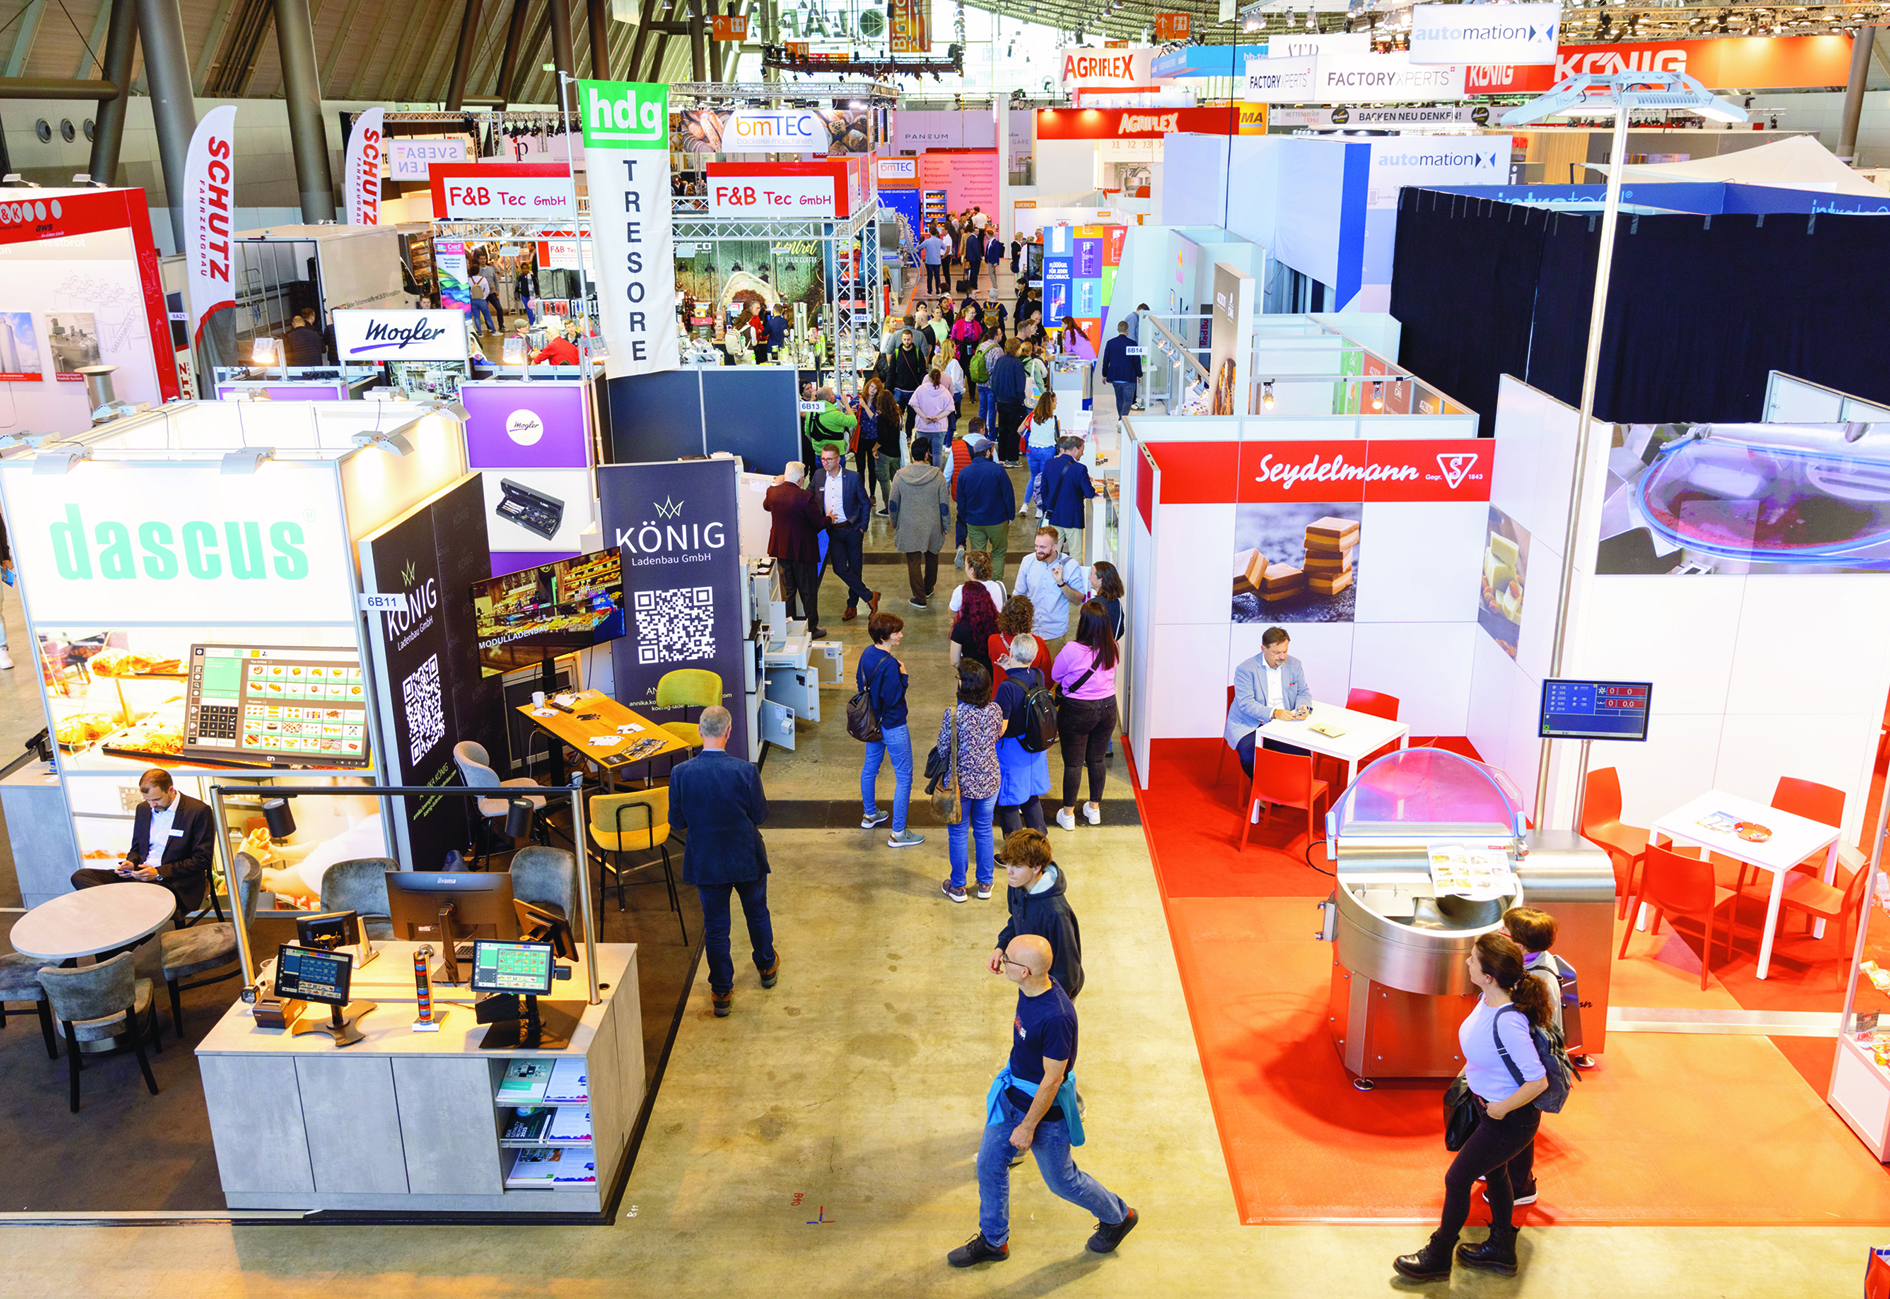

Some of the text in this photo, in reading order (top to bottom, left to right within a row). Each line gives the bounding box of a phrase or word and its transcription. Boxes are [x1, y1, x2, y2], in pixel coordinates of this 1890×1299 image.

[1062, 54, 1134, 82] AGRIFLEX
[1327, 71, 1450, 86] FACTORYXPERTS
[588, 88, 663, 141] hdg
[736, 115, 812, 136] bmTEC
[1118, 113, 1179, 134] AGRIFLEX
[1358, 112, 1393, 121] BACKEN
[1398, 112, 1417, 121] NEU
[362, 127, 380, 225] SCHUTZ
[207, 135, 230, 283] SCHUTZ
[449, 186, 567, 207] F&B Tec GmbH
[716, 186, 832, 207] F&B Tec GmbH
[199, 179, 207, 277] FAHRZEUGBAU
[550, 245, 565, 253] F&B
[622, 159, 647, 361] TRESORE
[365, 317, 445, 349] Mogler
[801, 402, 820, 410] 6B13
[514, 420, 539, 431] Mogler
[1255, 453, 1419, 490] Seydelmann
[49, 502, 310, 581] dascus
[615, 520, 726, 554] KÖNIG
[631, 552, 712, 567] Ladenbau GmbH
[367, 596, 397, 607] 6B11
[397, 614, 434, 651] Ladenbau GmbH
[478, 624, 549, 650] MODULLADENBAU
